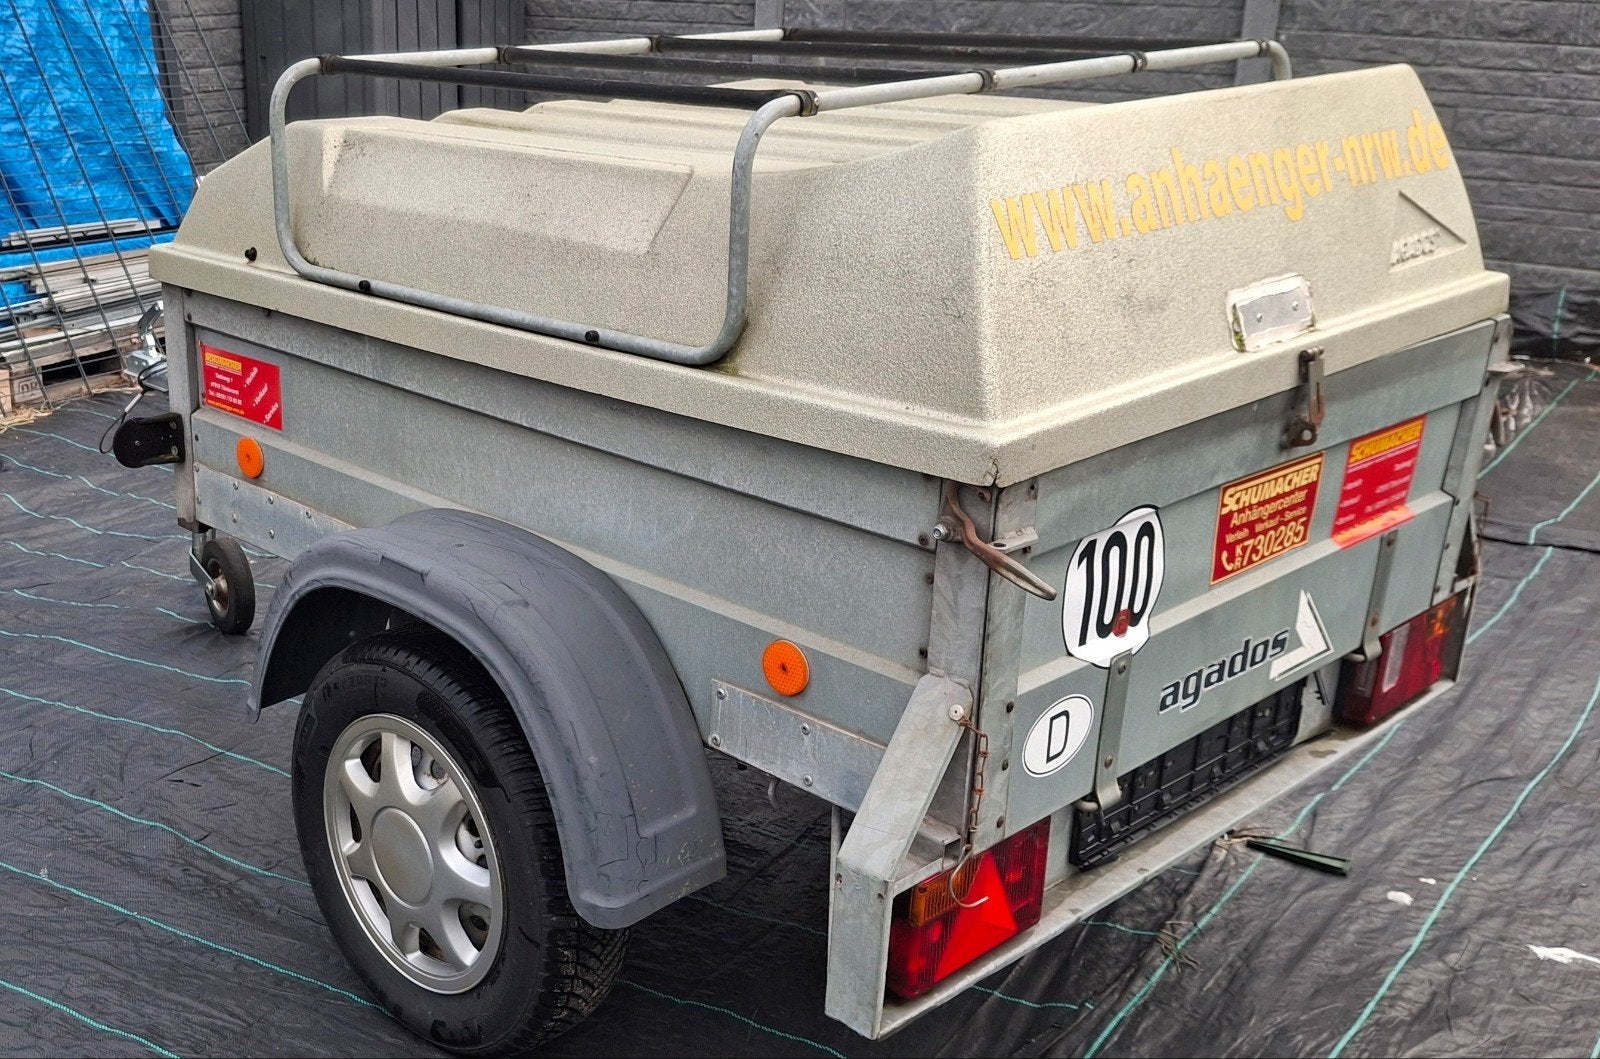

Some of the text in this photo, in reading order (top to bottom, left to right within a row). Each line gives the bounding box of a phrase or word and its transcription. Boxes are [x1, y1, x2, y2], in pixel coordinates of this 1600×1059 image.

[991, 109, 1450, 260] www.anhaenger-nrw.de
[1221, 463, 1320, 515] SCHUMACHER
[1229, 489, 1308, 528] Anhängercenter
[1242, 517, 1307, 566] 730285
[1077, 520, 1155, 647] 100
[1158, 628, 1290, 714] agados
[1046, 709, 1070, 764] D
